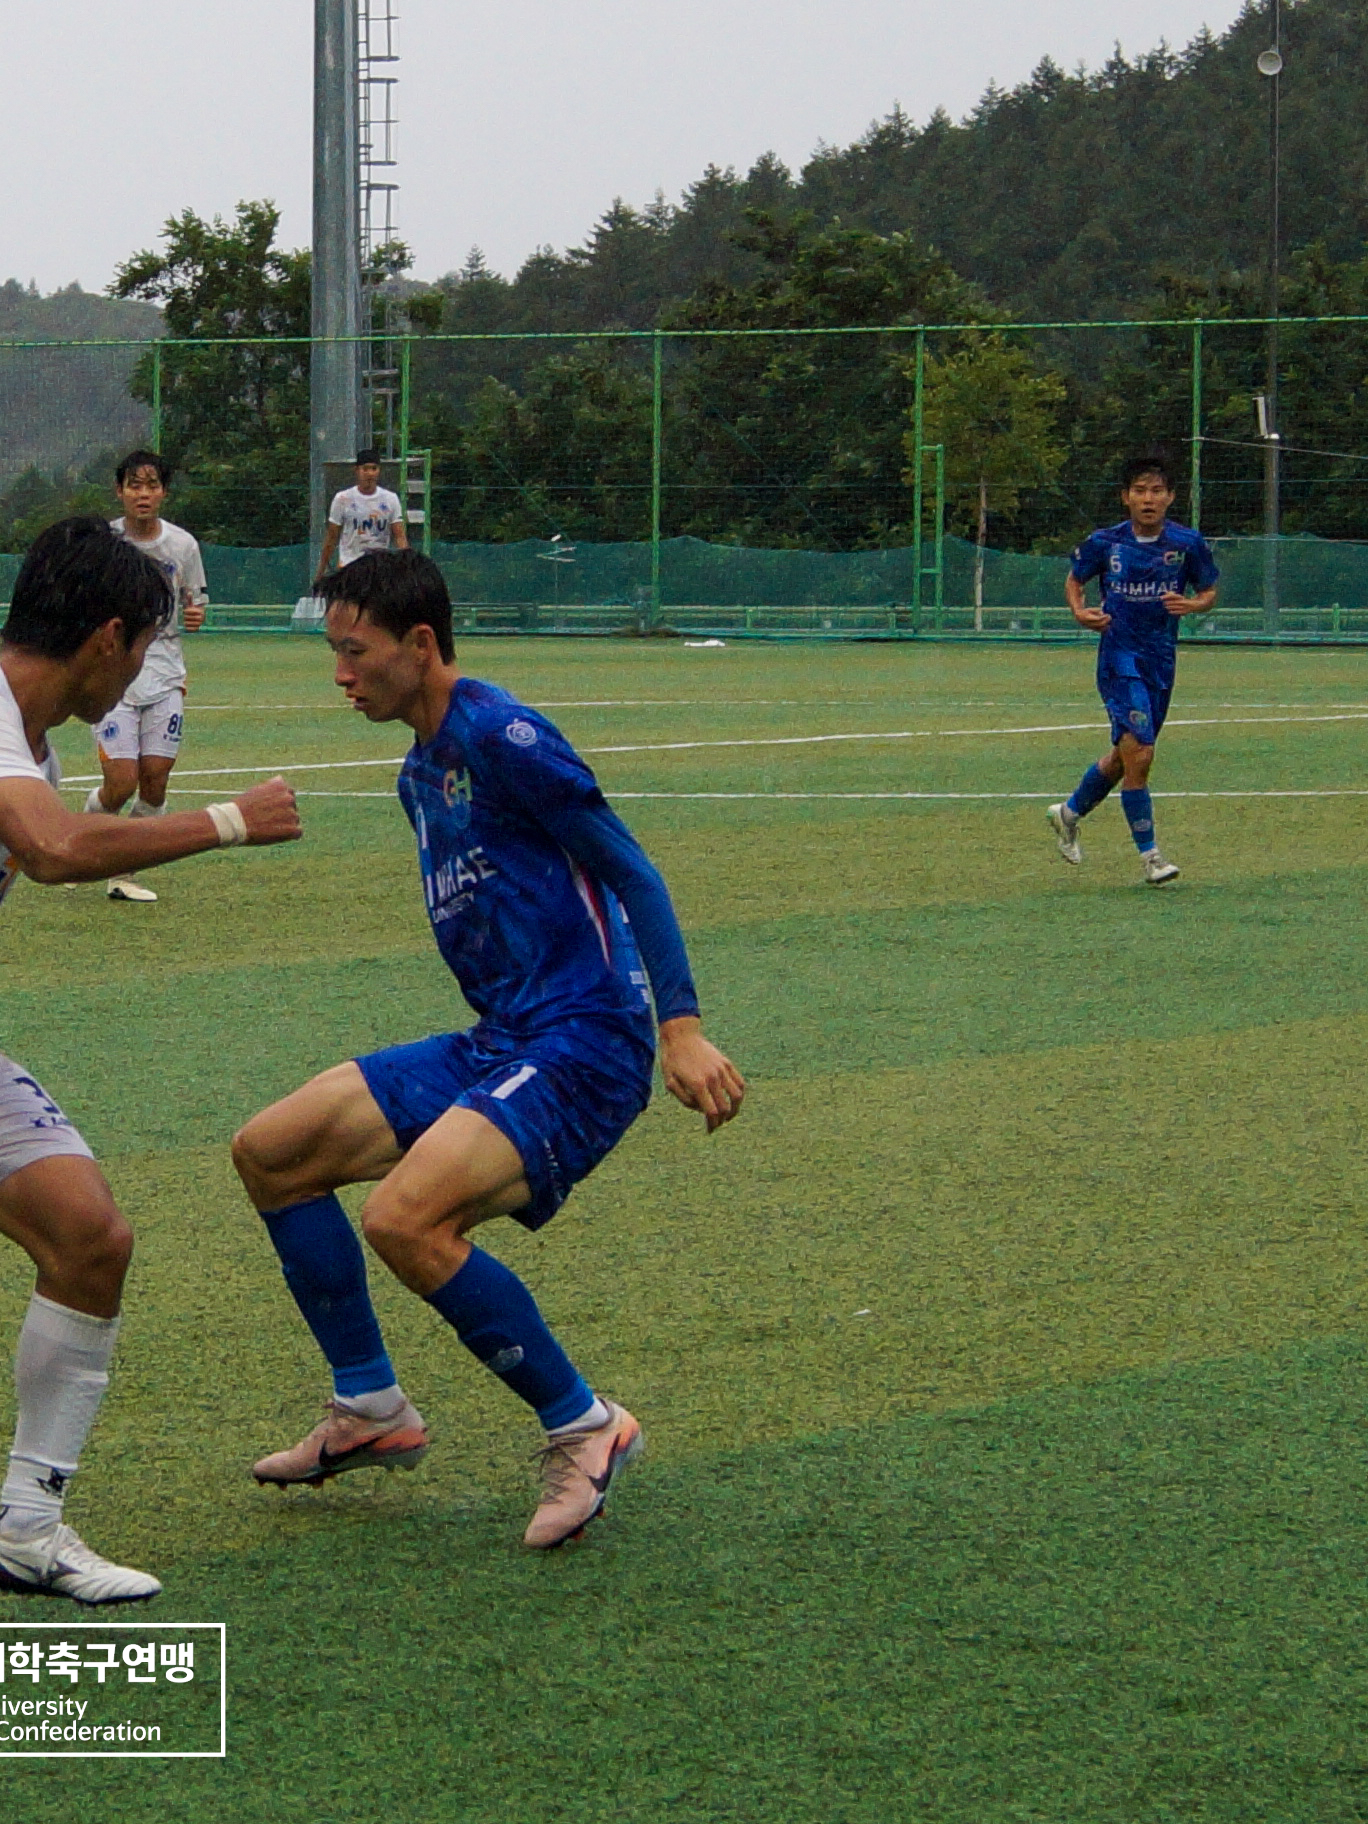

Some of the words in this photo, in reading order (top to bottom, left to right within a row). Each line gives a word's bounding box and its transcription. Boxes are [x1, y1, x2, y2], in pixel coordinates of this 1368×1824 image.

[353, 517, 388, 532] INU
[1110, 554, 1122, 572] 6
[490, 1065, 538, 1100] 1
